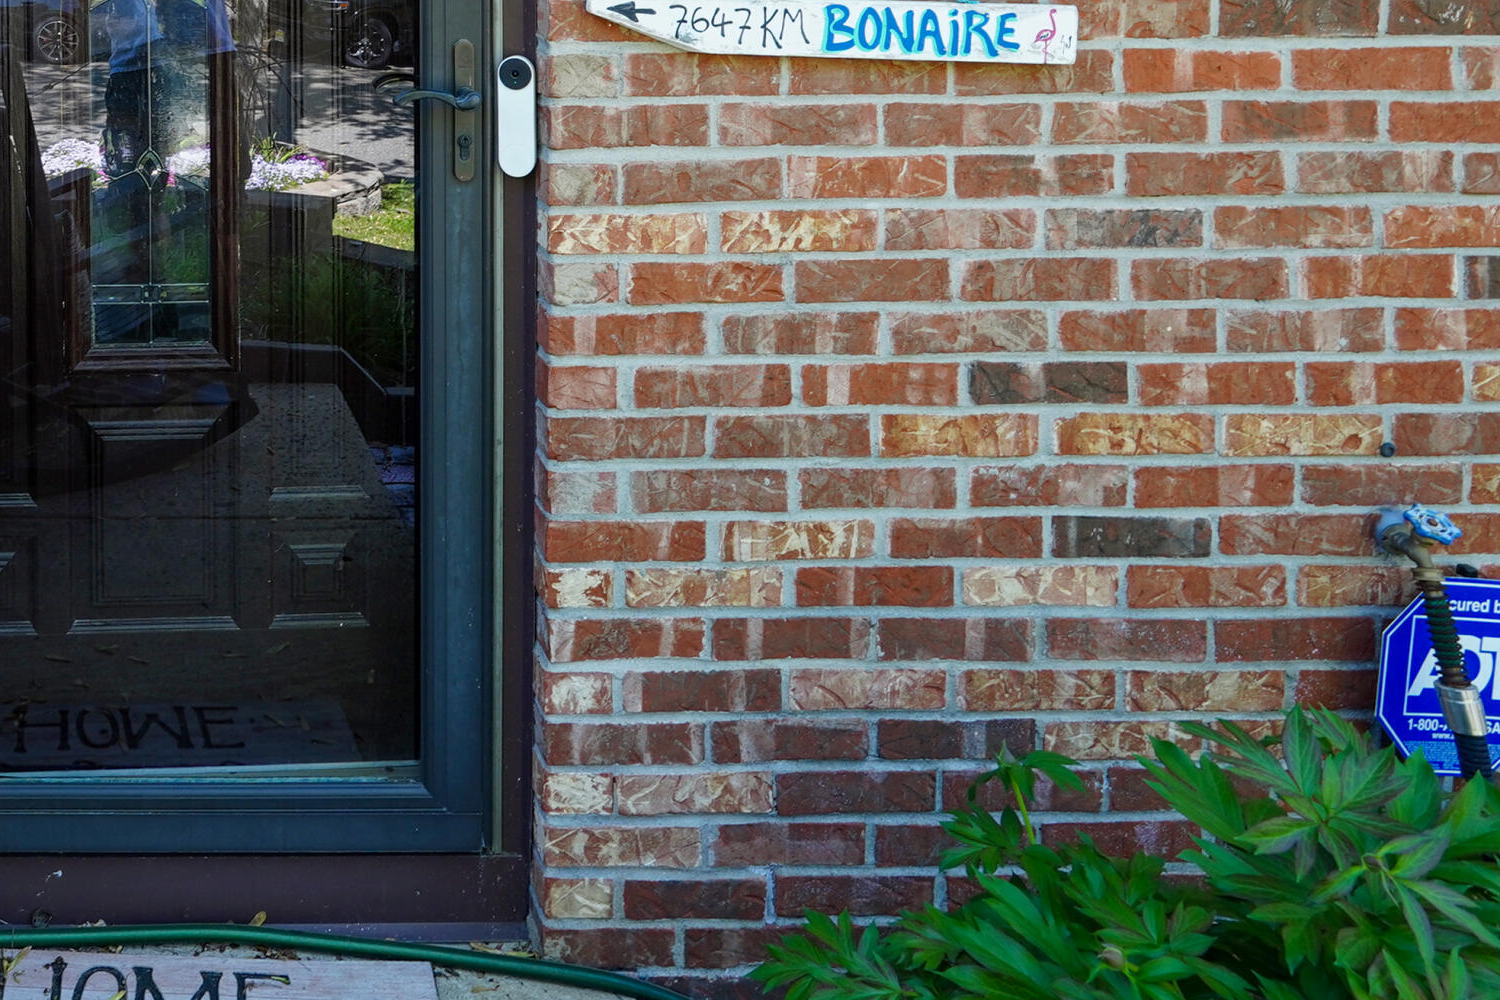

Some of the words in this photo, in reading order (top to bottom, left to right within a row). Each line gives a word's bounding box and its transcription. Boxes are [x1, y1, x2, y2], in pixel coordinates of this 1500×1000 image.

[669, 4, 752, 46] 7647
[760, 6, 811, 50] KM
[1448, 599, 1491, 613] cured
